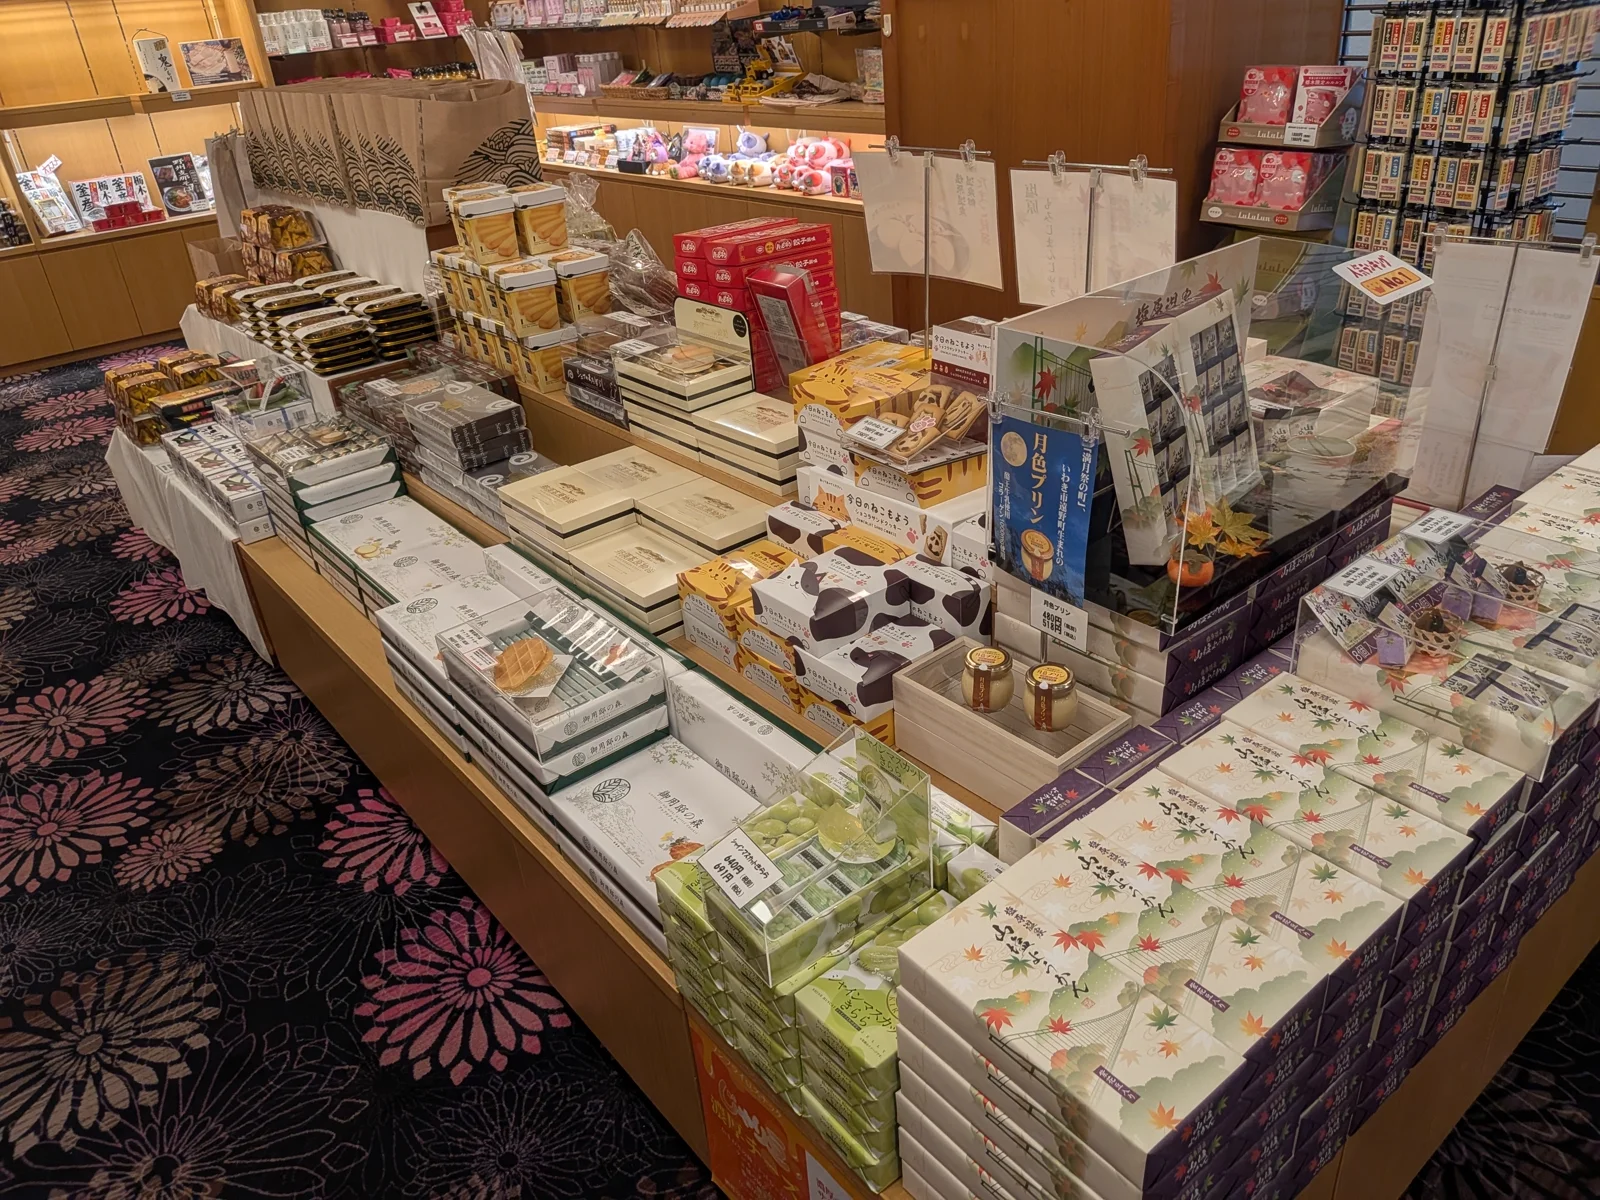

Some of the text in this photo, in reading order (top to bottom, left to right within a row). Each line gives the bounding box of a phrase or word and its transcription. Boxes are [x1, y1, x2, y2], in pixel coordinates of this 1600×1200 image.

[1238, 210, 1270, 222] LuLuLun
[1379, 271, 1413, 289] No.1
[934, 334, 975, 351] 今日のねこもよう
[867, 466, 908, 485] 今日のねこもよう
[1030, 432, 1048, 524] 月色プリン
[847, 494, 909, 526] 今日のねこもよう
[855, 509, 902, 531] ショコラサンドクッキー
[1055, 464, 1071, 566] いわき市遠野町生まれの
[831, 558, 871, 579] 今日のねこもよう
[764, 605, 802, 629] 今日のねこもよう
[1042, 610, 1063, 626] 480円
[1043, 599, 1071, 616] 月色プリン
[1042, 618, 1062, 635] 518円
[807, 667, 848, 695] 今日のねこもよう
[582, 700, 622, 723] 御用邸の森
[590, 731, 629, 754] 御用邸の森
[714, 758, 759, 798] 御用邸の森
[657, 790, 704, 829] 御用邸の森
[1167, 788, 1210, 814] 塩原温泉
[1159, 801, 1255, 860] 山塩ようかん
[724, 855, 744, 875] 640円
[731, 838, 769, 879] シャインマスカットきらら
[1088, 840, 1130, 867] 塩原温泉
[713, 862, 734, 883] 691円
[1078, 855, 1175, 919] 山塩ようかん
[1004, 906, 1047, 939] 塩原温泉
[992, 924, 1089, 999] 山塩ようかん
[828, 974, 897, 1033] シャインマスカッ
[840, 1000, 870, 1027] きらら
